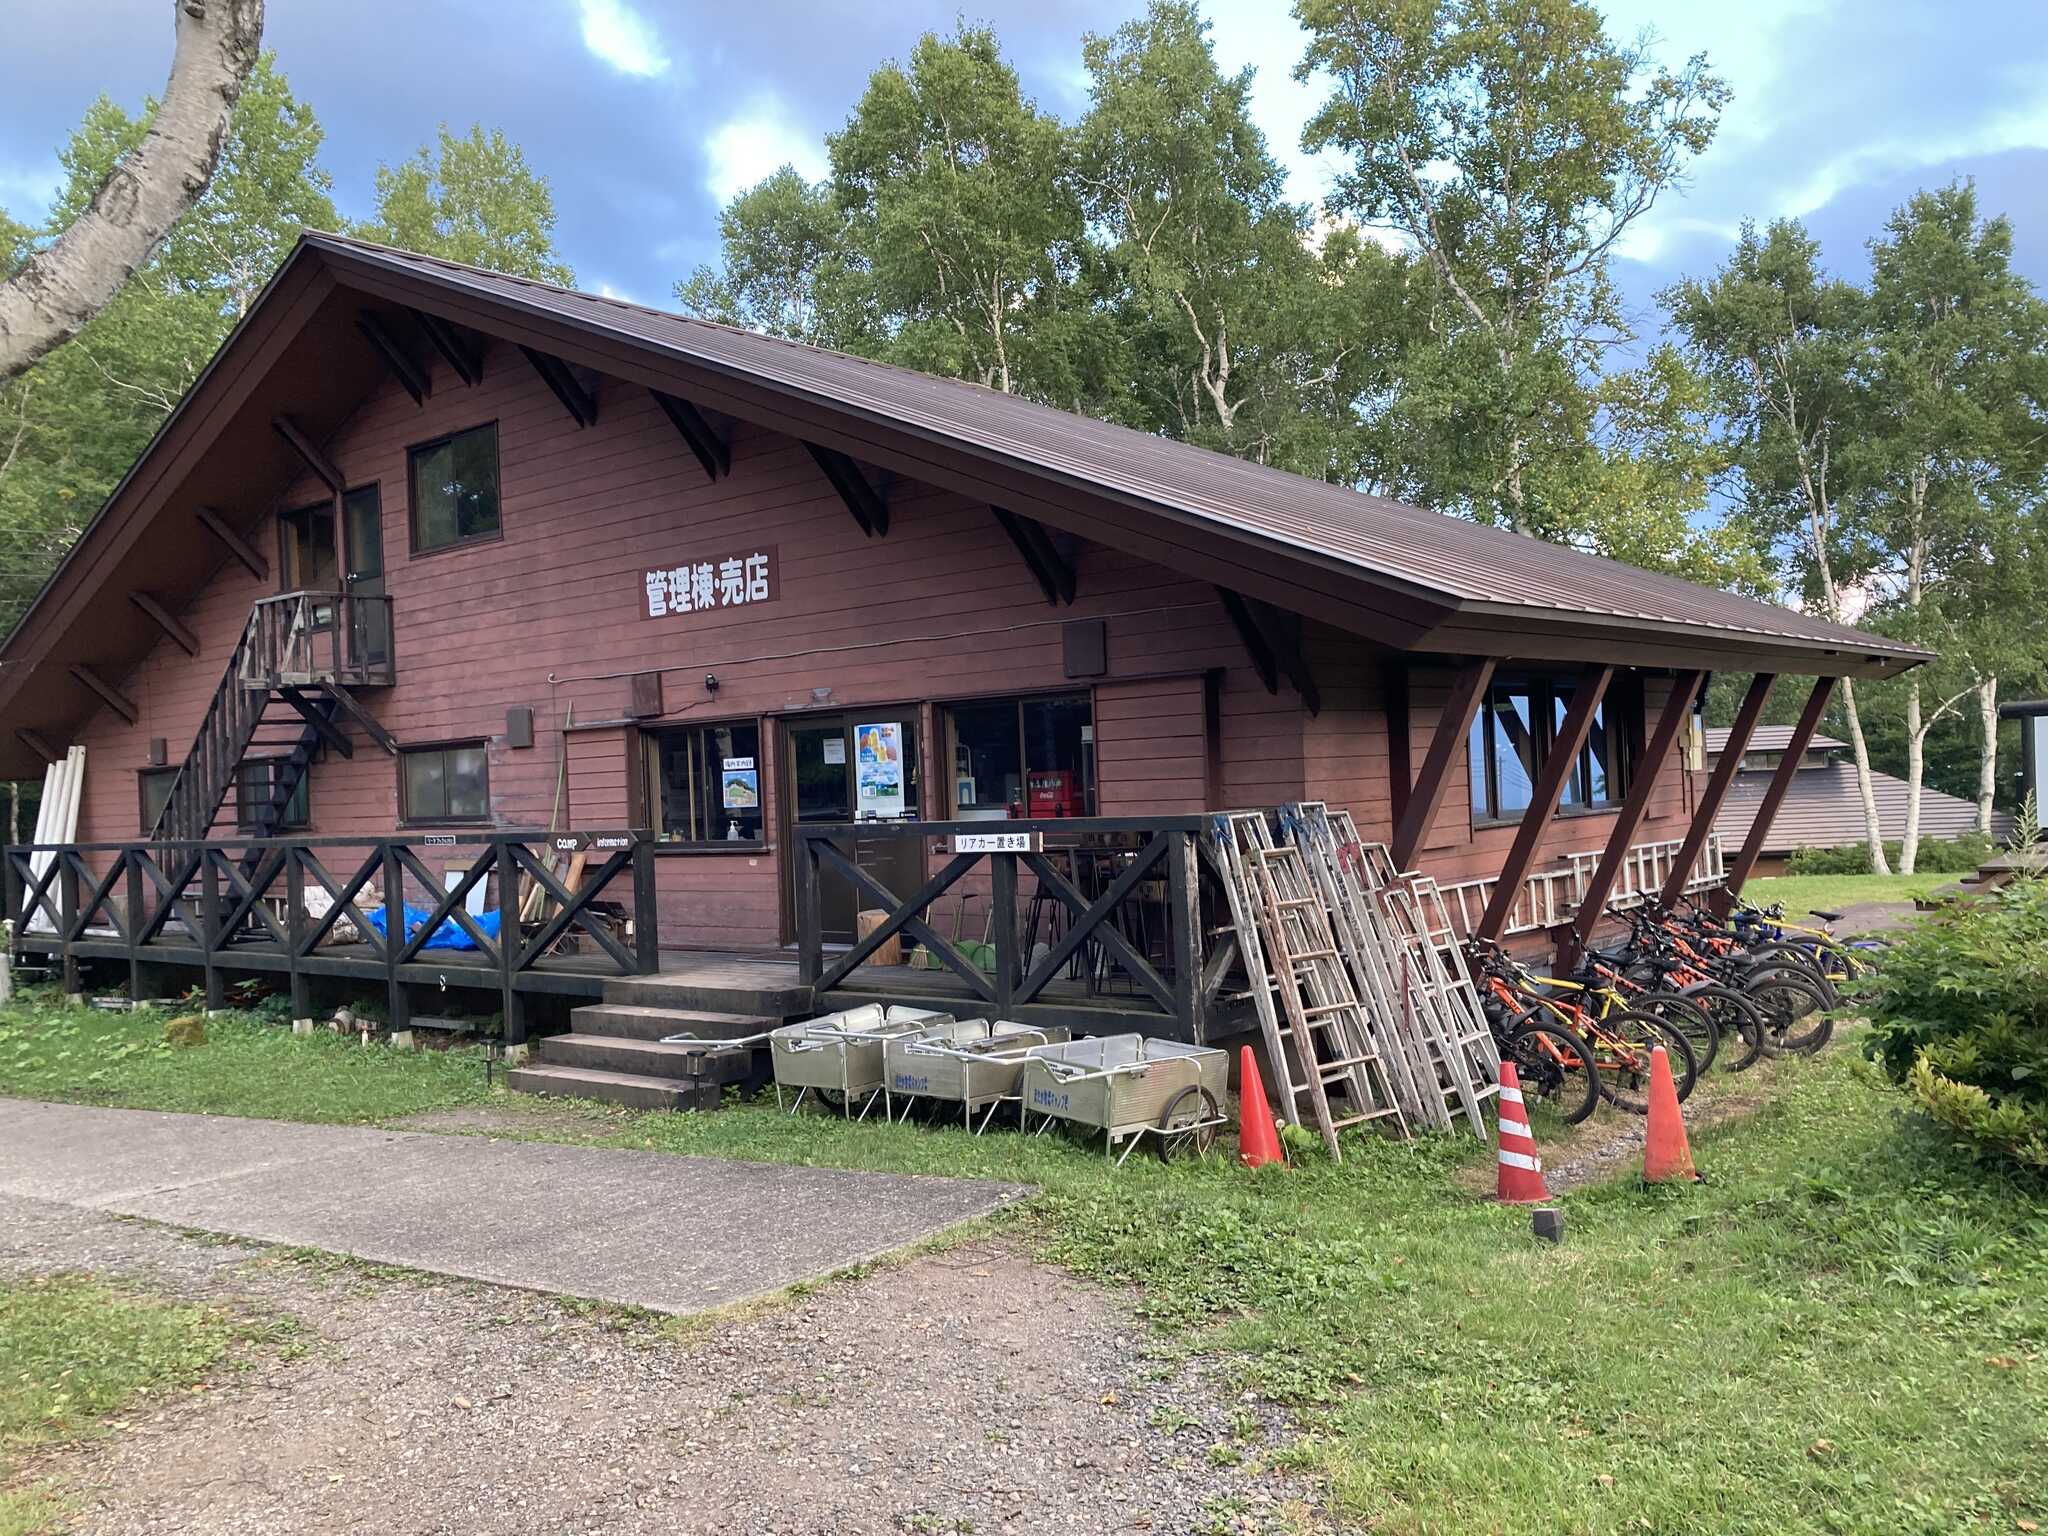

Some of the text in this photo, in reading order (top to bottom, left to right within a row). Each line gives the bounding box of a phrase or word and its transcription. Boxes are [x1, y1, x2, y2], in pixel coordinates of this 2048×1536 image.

[961, 836, 1025, 849] リアカー置き場
